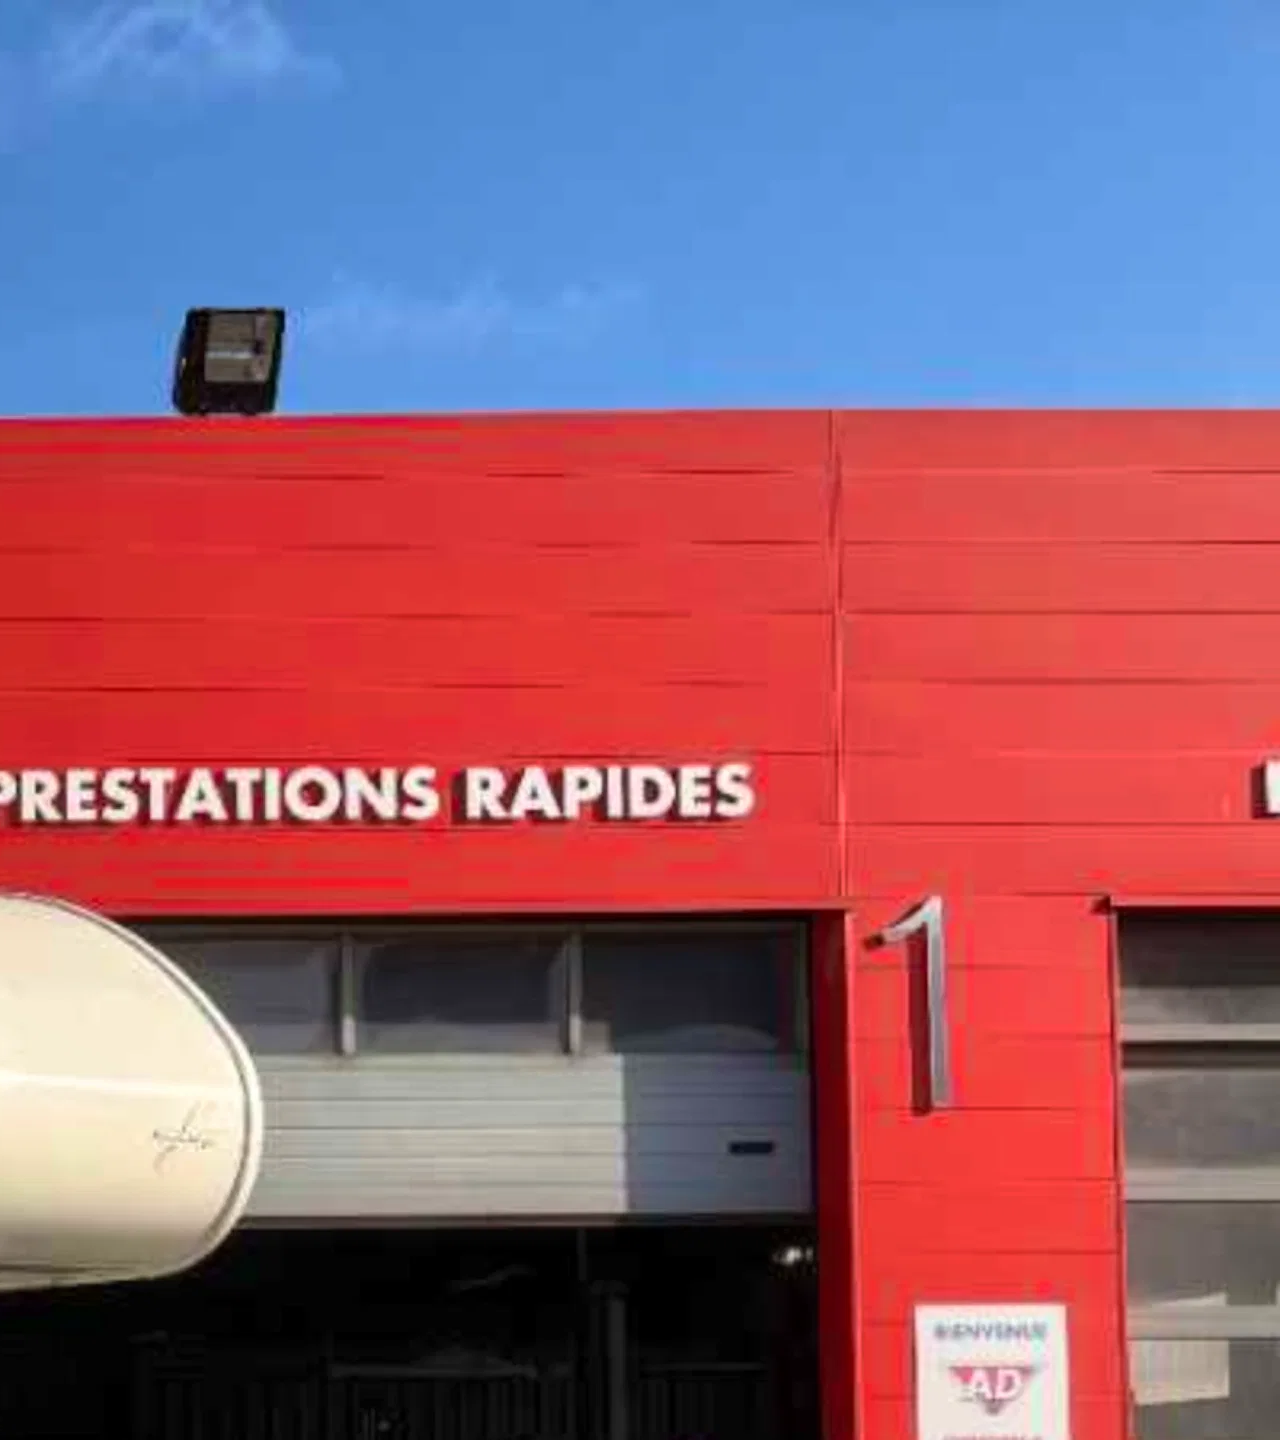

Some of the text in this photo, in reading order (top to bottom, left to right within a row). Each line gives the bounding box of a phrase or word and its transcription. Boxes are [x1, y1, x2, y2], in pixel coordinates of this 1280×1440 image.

[465, 763, 755, 820] RAPIDES
[881, 895, 952, 1108] 1
[969, 1367, 1024, 1401] AD
